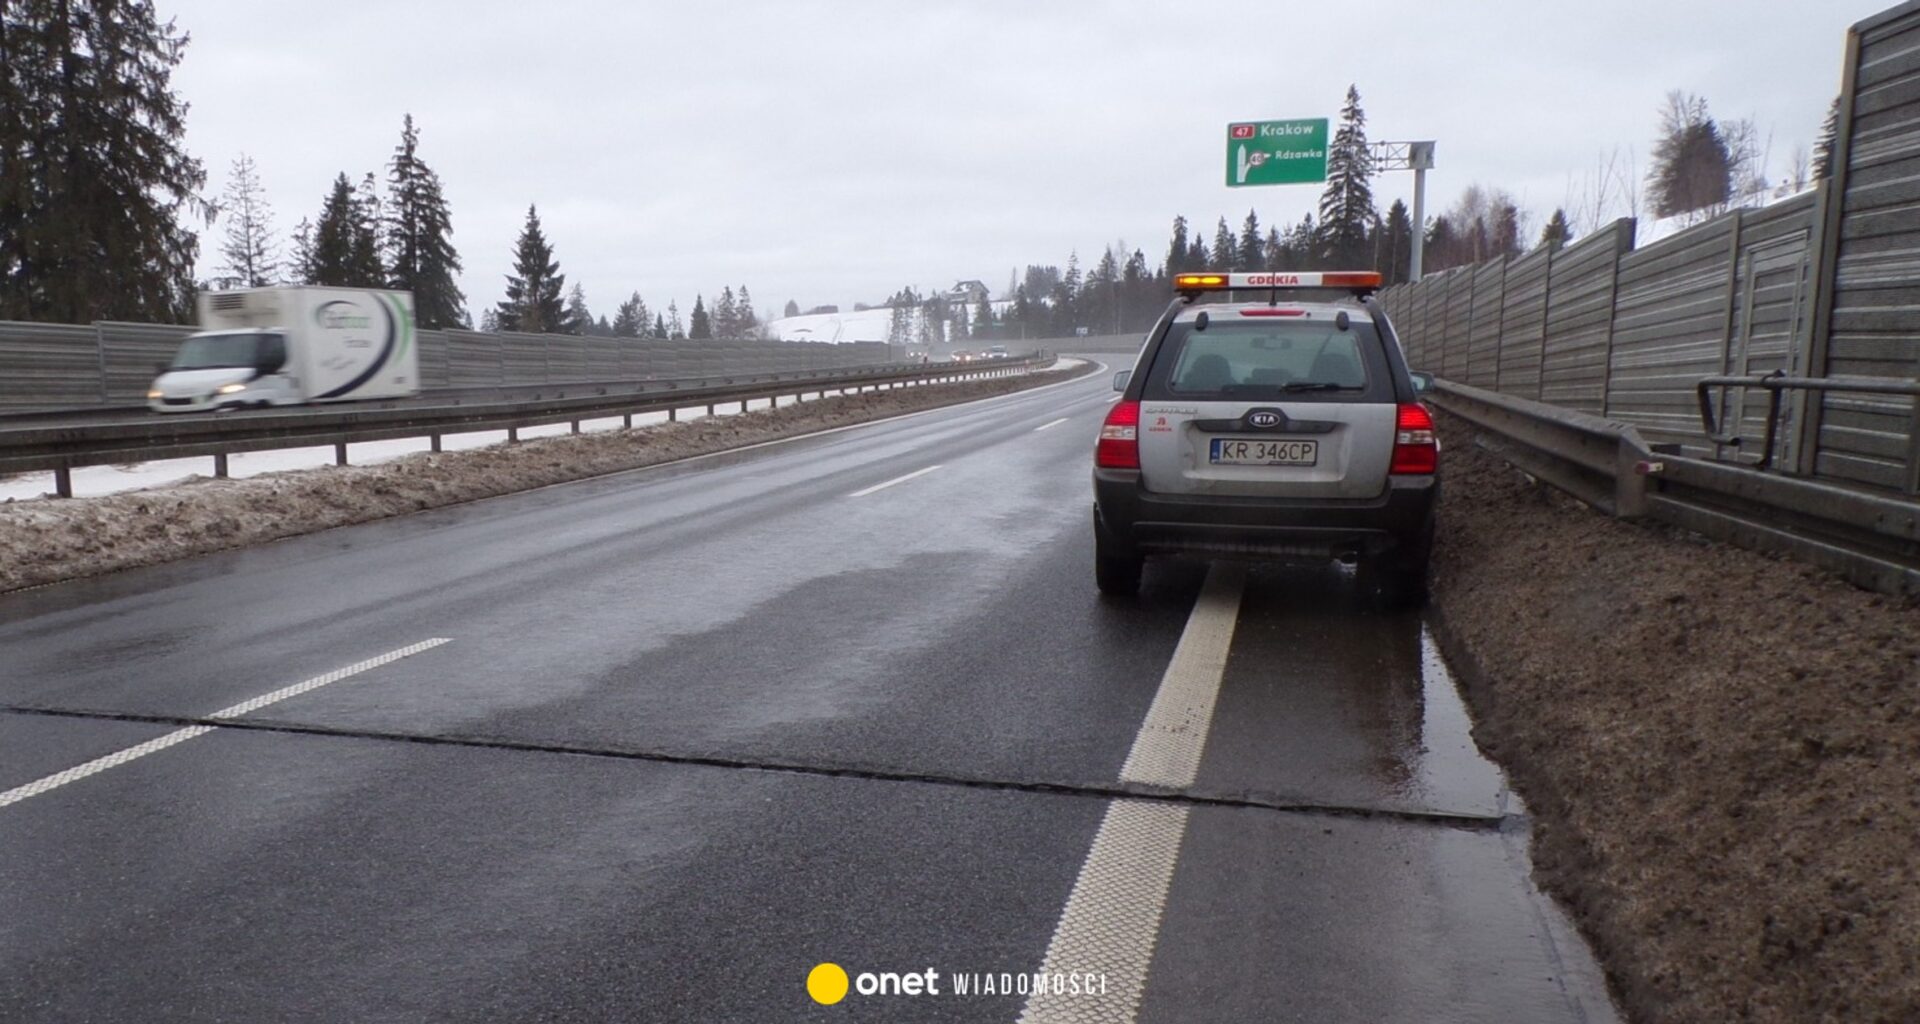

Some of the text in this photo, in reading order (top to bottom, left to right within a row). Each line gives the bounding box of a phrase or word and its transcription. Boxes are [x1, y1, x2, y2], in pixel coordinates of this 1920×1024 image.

[1236, 127, 1249, 136] 47
[1275, 148, 1323, 160] Rdzawka
[1253, 416, 1275, 424] KIA
[1222, 442, 1312, 460] KR 346CP
